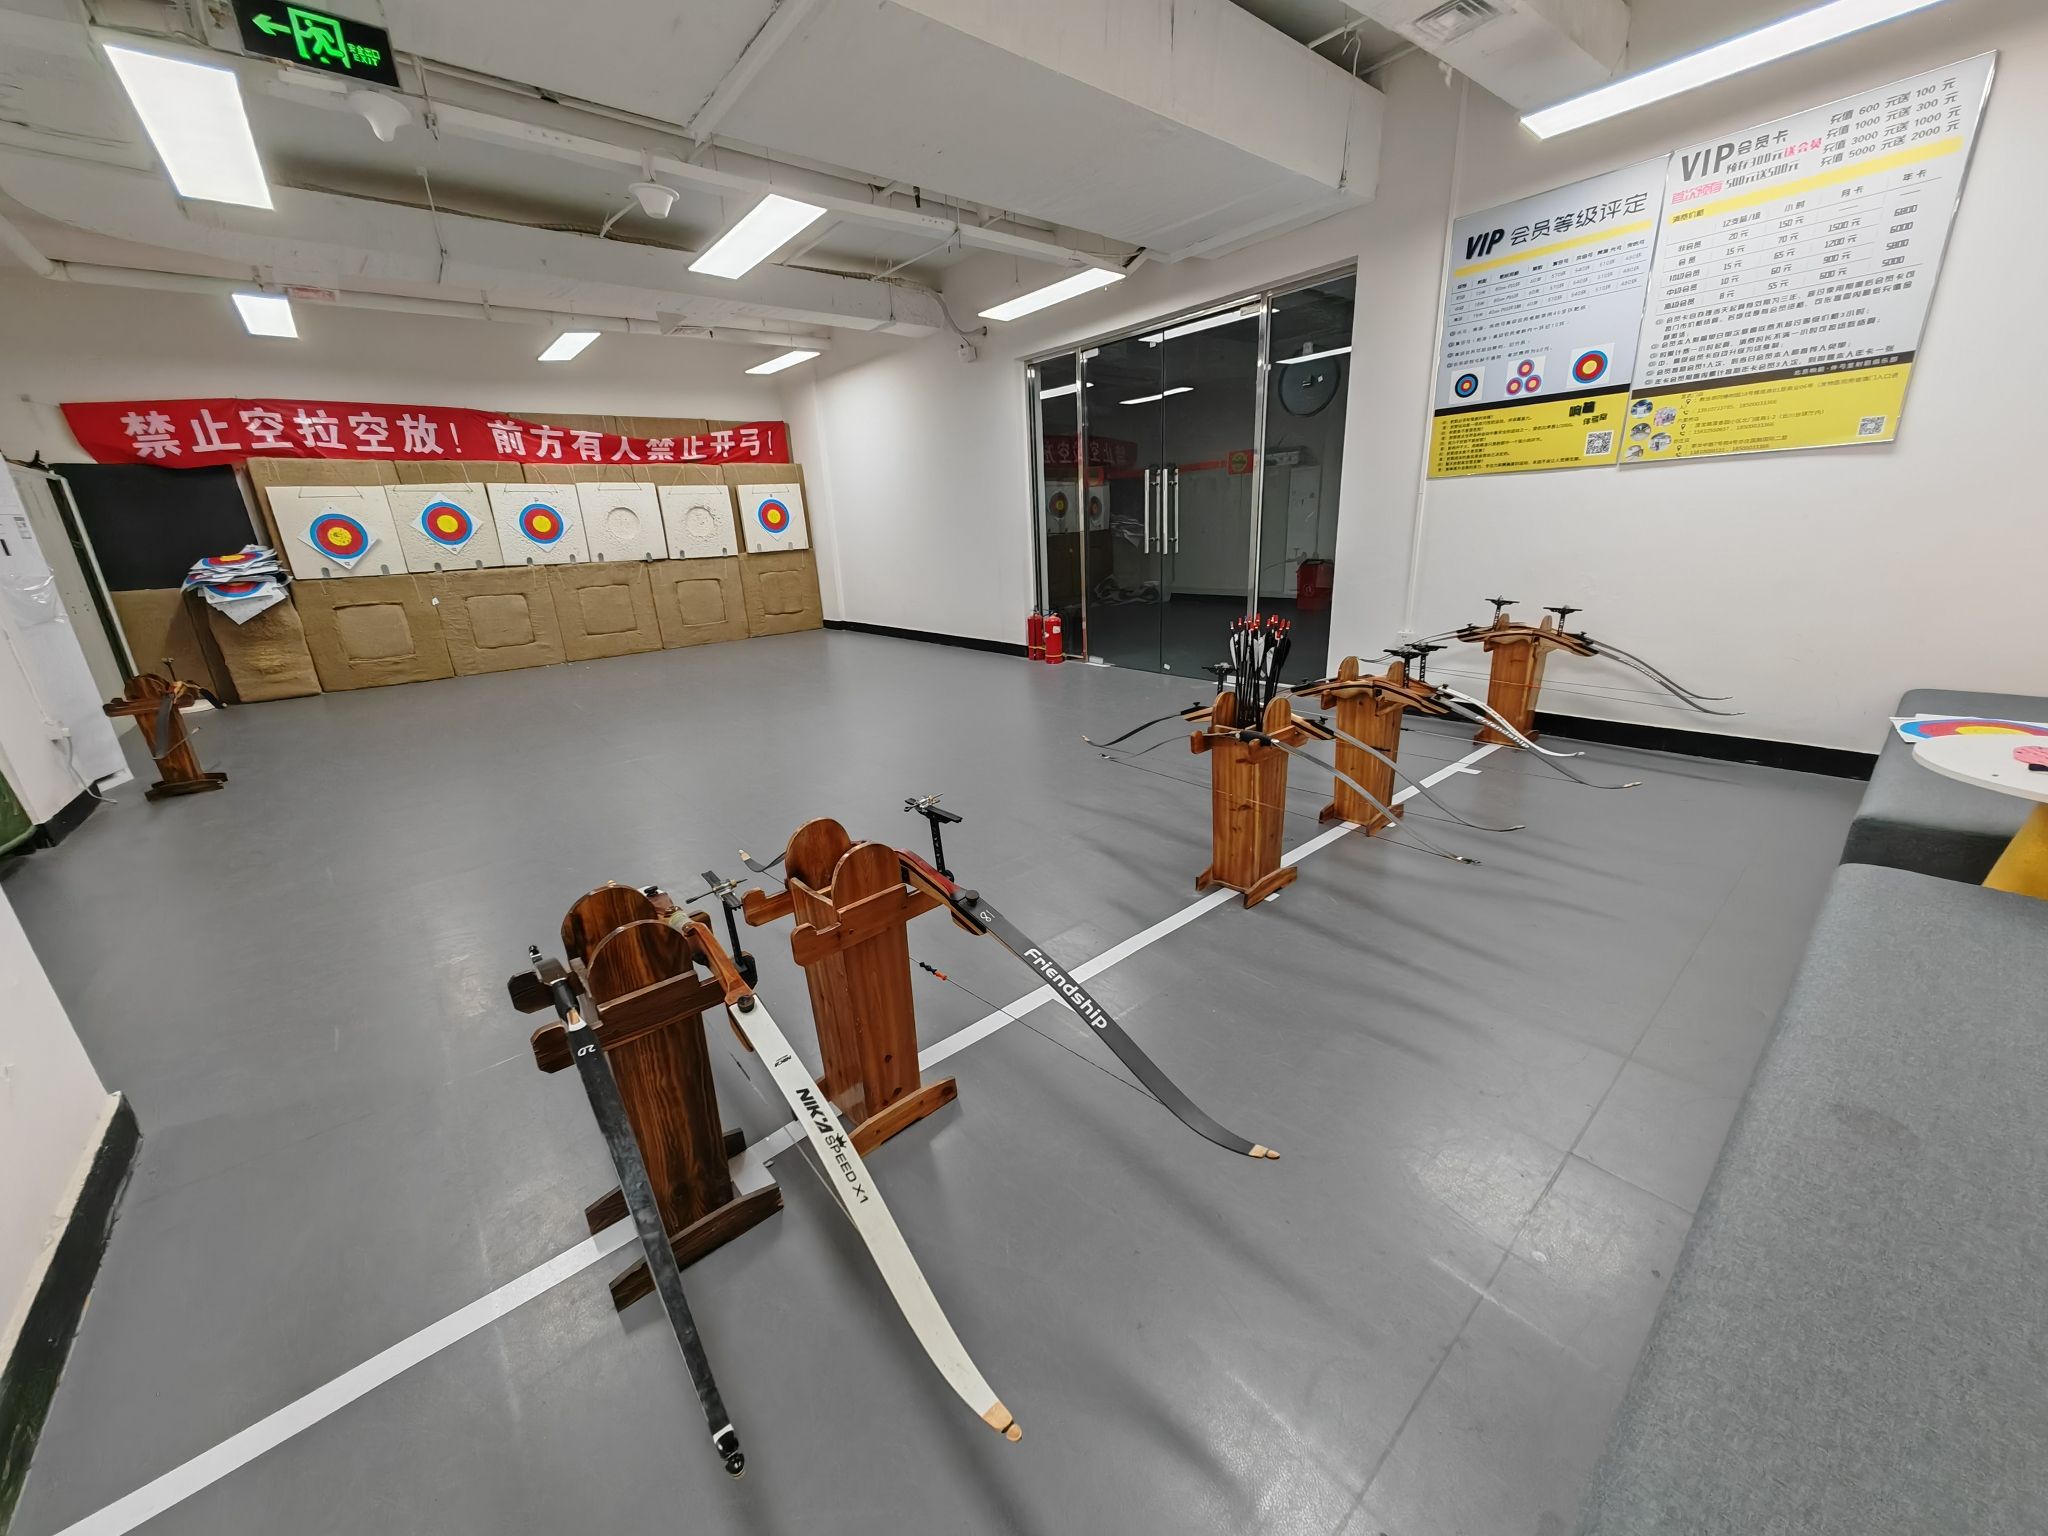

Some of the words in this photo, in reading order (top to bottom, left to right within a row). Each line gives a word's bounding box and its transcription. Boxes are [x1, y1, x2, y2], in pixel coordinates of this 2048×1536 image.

[353, 54, 378, 66] EXIT
[1855, 115, 1880, 130] 1000
[1916, 98, 1939, 112] 300
[1944, 91, 1958, 104] 元
[1858, 102, 1880, 116] 600
[1915, 85, 1936, 98] 100
[1941, 77, 1957, 91] 元
[1848, 145, 1876, 159] 5000
[1911, 126, 1940, 141] 2000
[1945, 119, 1961, 133] 元
[1851, 130, 1878, 145] 3000
[1914, 112, 1941, 127] 1000
[1947, 105, 1962, 118] 元
[1465, 228, 1505, 260] VIP
[1510, 192, 1648, 246] 会员等级评定
[1678, 240, 1702, 253] 非会员
[120, 407, 463, 459] 禁止空拉空放！
[487, 420, 776, 461] 前方有人禁止开弓！
[1024, 948, 1108, 1029] Friendship
[825, 1134, 857, 1183] SPEED
[852, 1182, 869, 1205] X1
